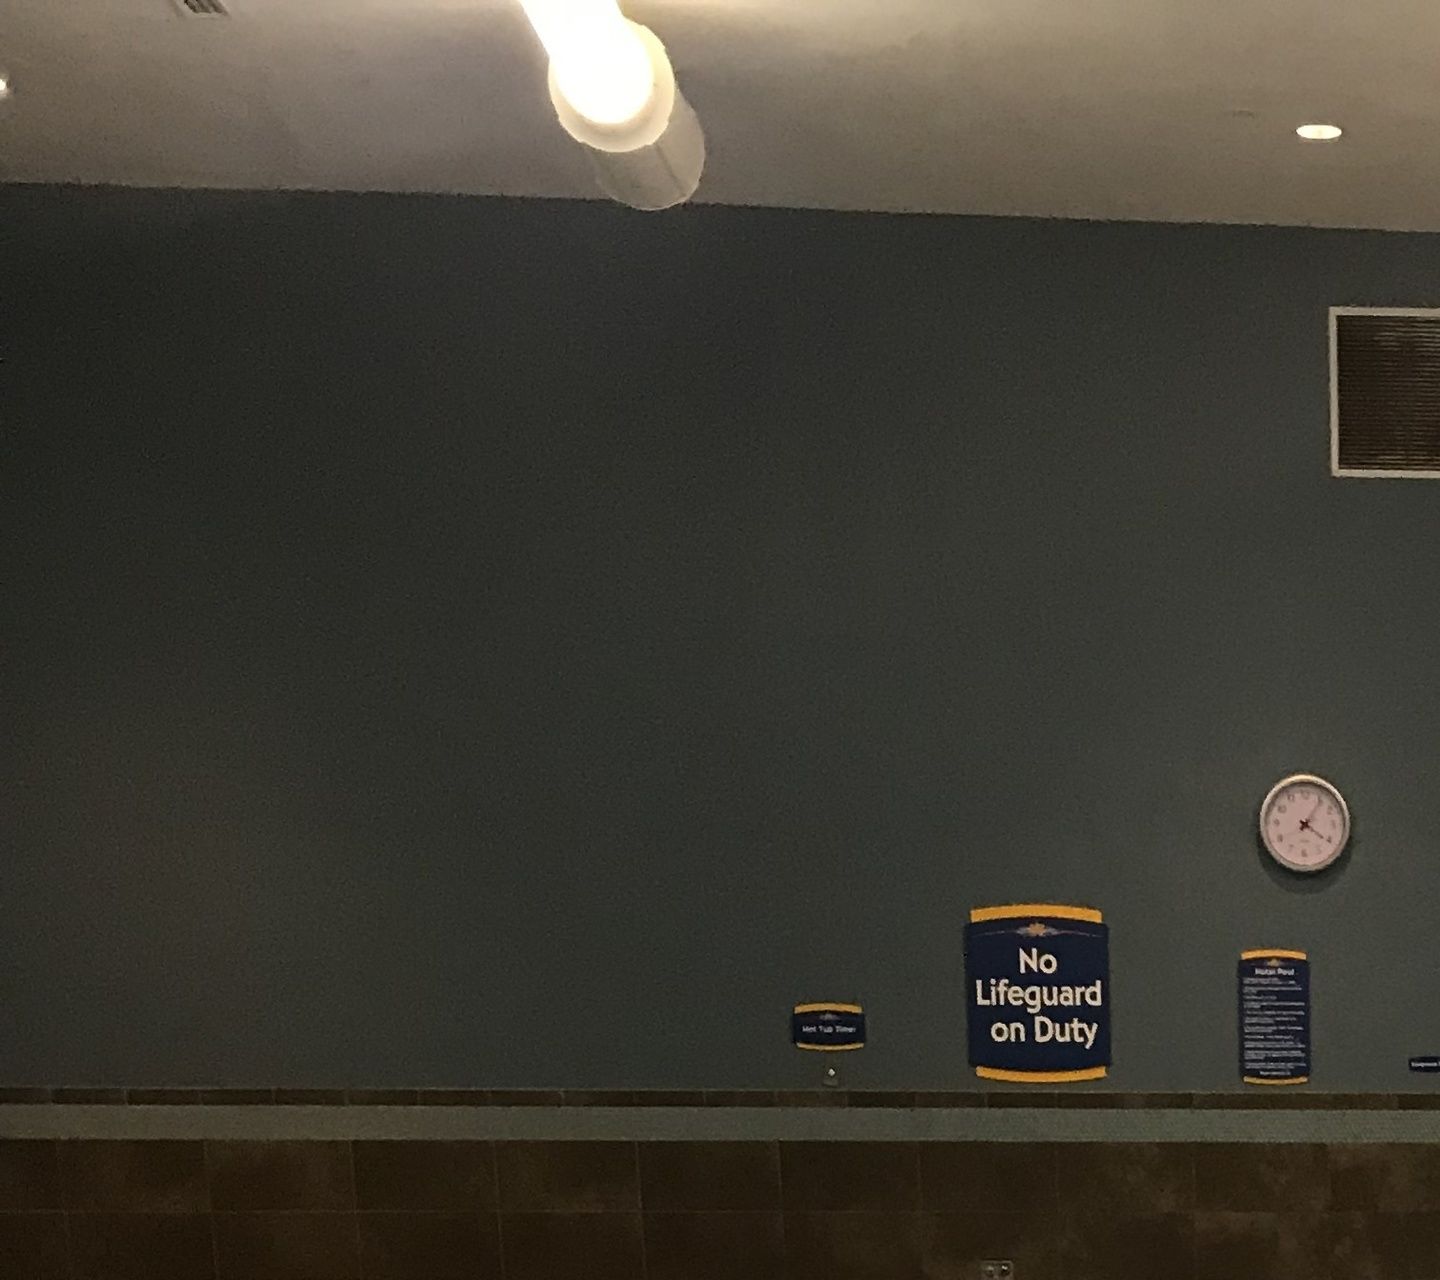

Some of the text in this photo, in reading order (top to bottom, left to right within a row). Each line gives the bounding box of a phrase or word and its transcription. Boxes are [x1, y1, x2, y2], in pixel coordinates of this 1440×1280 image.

[1018, 947, 1058, 975] No
[975, 978, 1102, 1014] Lifeguard
[990, 1015, 1098, 1049] on Duty
